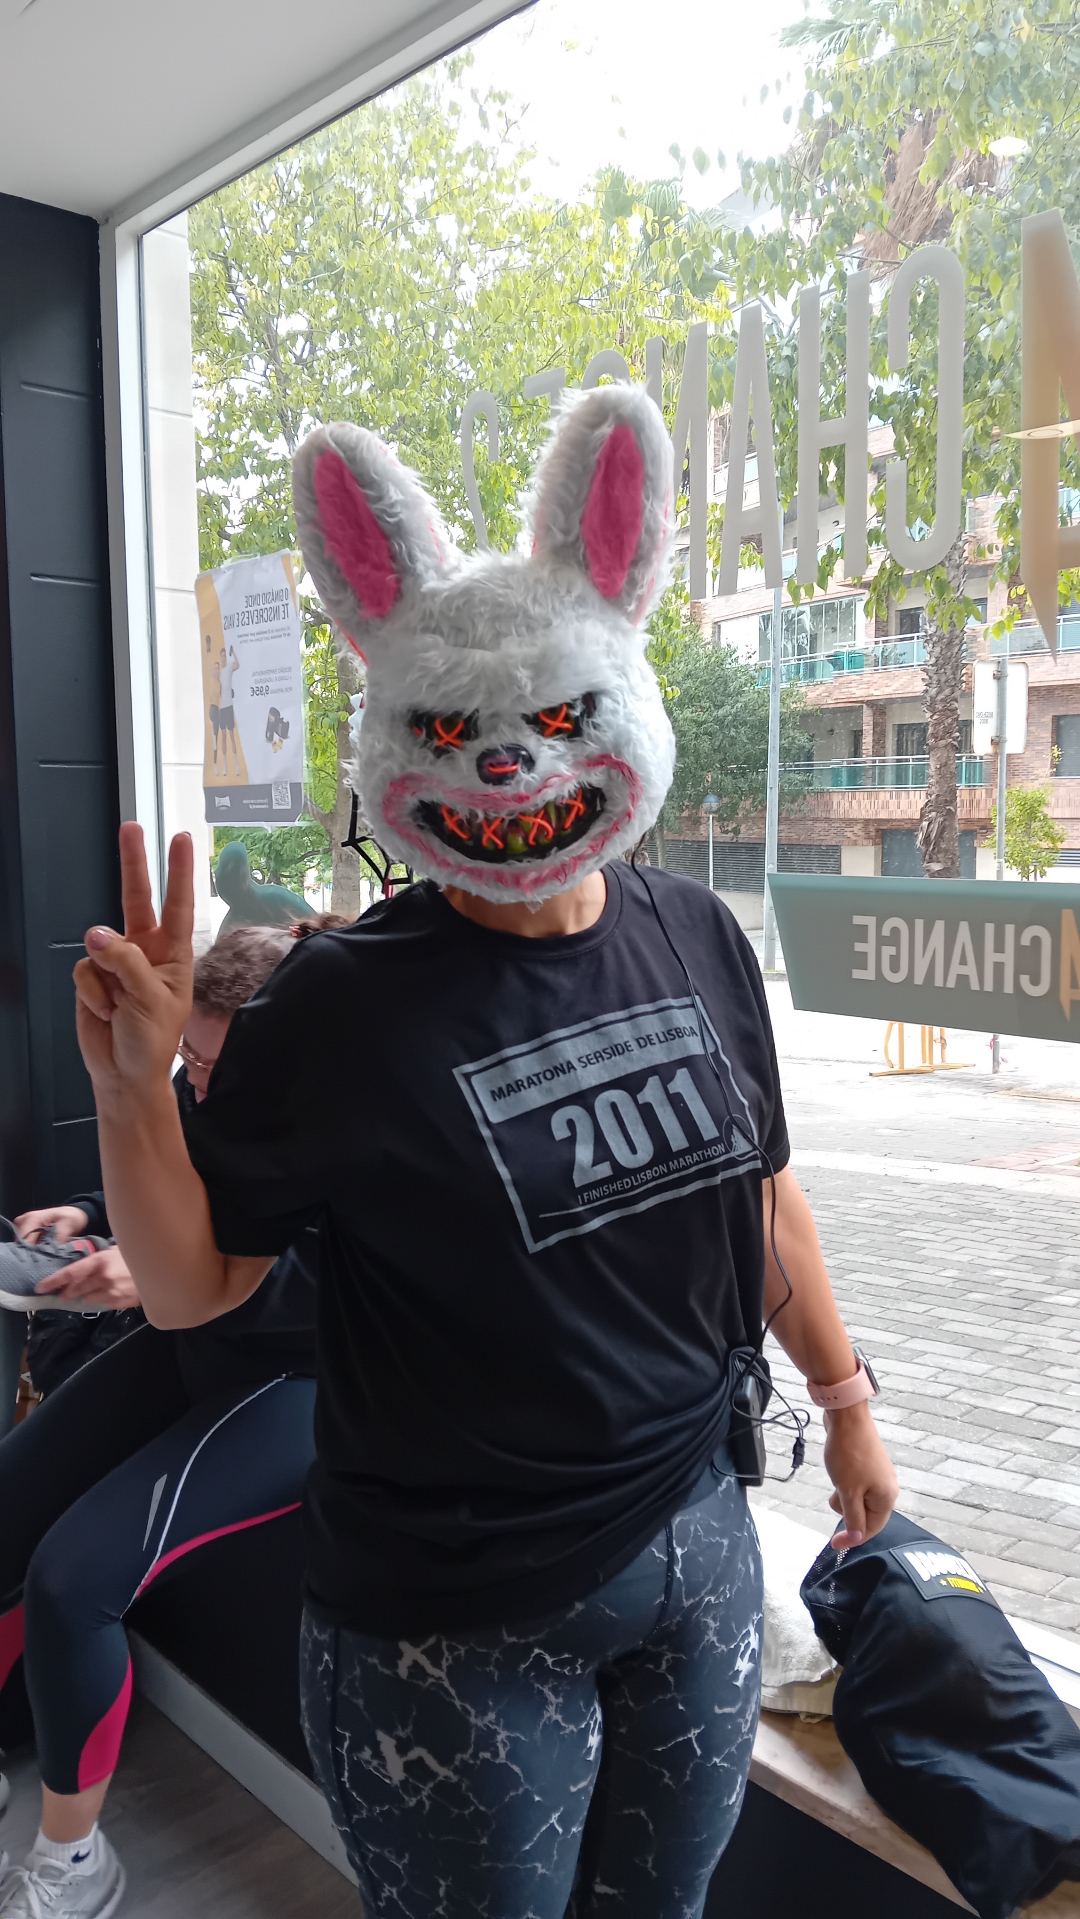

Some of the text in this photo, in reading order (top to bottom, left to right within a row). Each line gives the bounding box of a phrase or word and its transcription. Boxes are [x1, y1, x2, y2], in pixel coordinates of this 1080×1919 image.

[490, 1025, 699, 1102] MARATONA SEASIDE DE LISBOA
[551, 1067, 719, 1188] 2011
[577, 1142, 726, 1205] I FINISHED LISBON MARATHON
